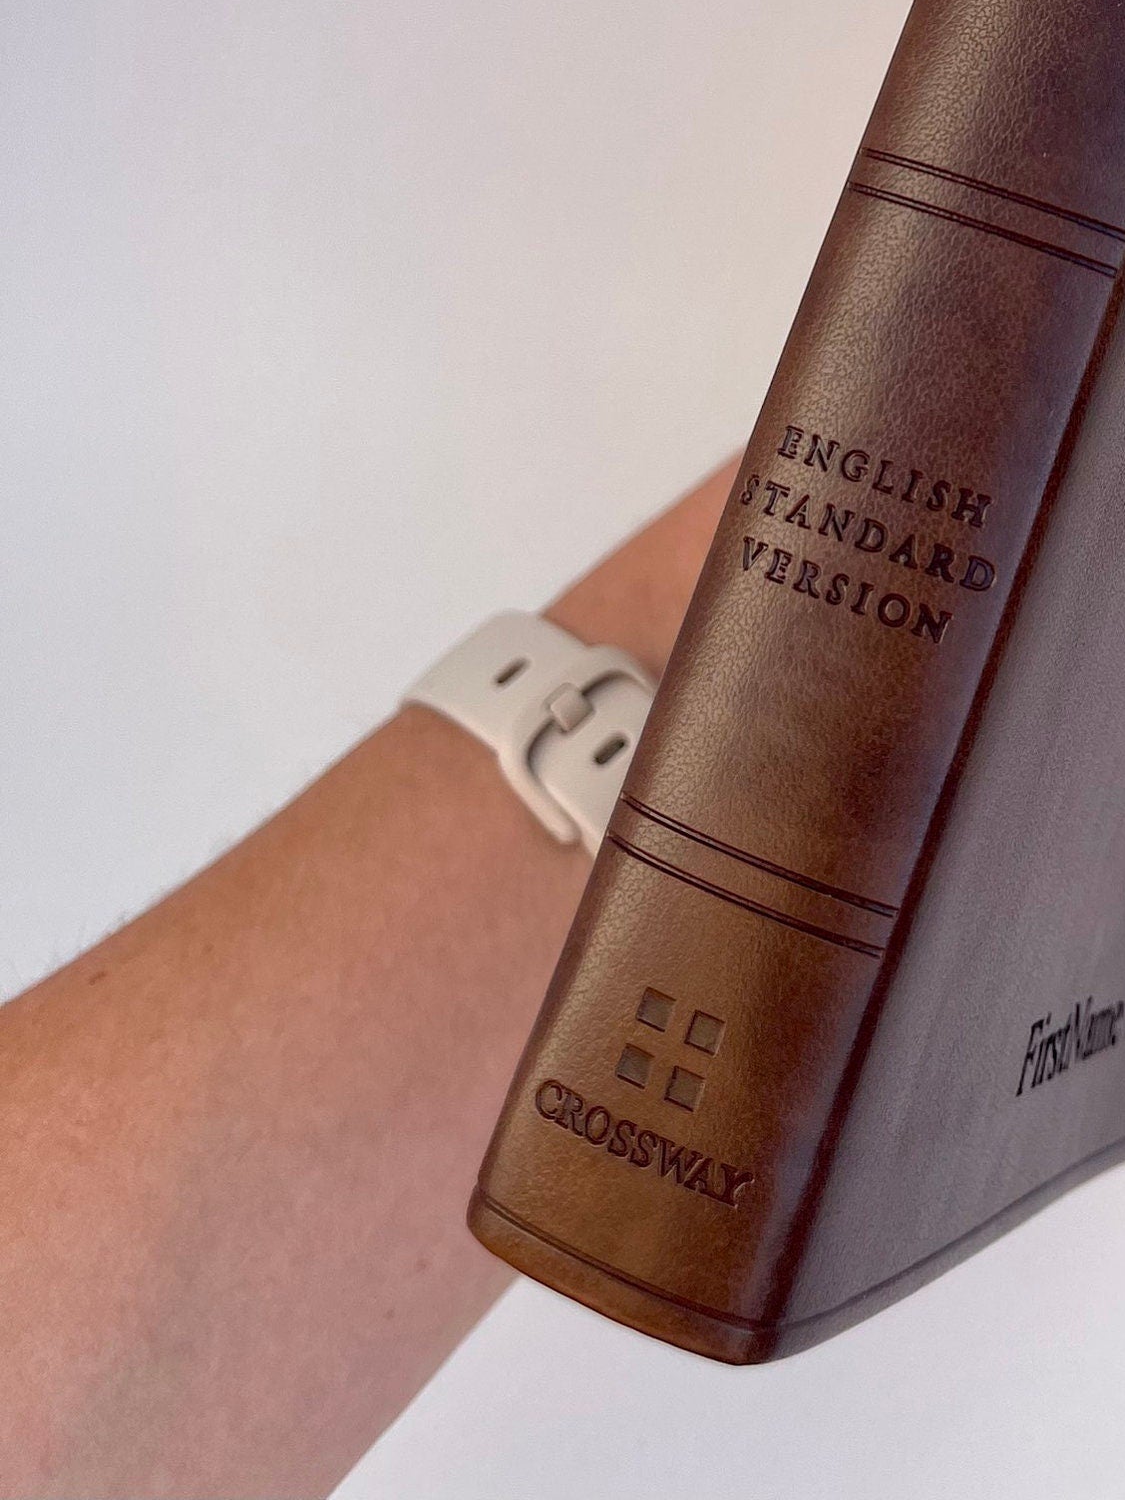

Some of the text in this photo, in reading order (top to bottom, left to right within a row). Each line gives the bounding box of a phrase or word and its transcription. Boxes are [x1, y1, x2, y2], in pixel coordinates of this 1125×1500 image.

[741, 474, 996, 592] STANDARD
[777, 425, 993, 528] ENGLISH
[742, 536, 952, 644] VERSION
[535, 1079, 755, 1208] CROSSWAY
